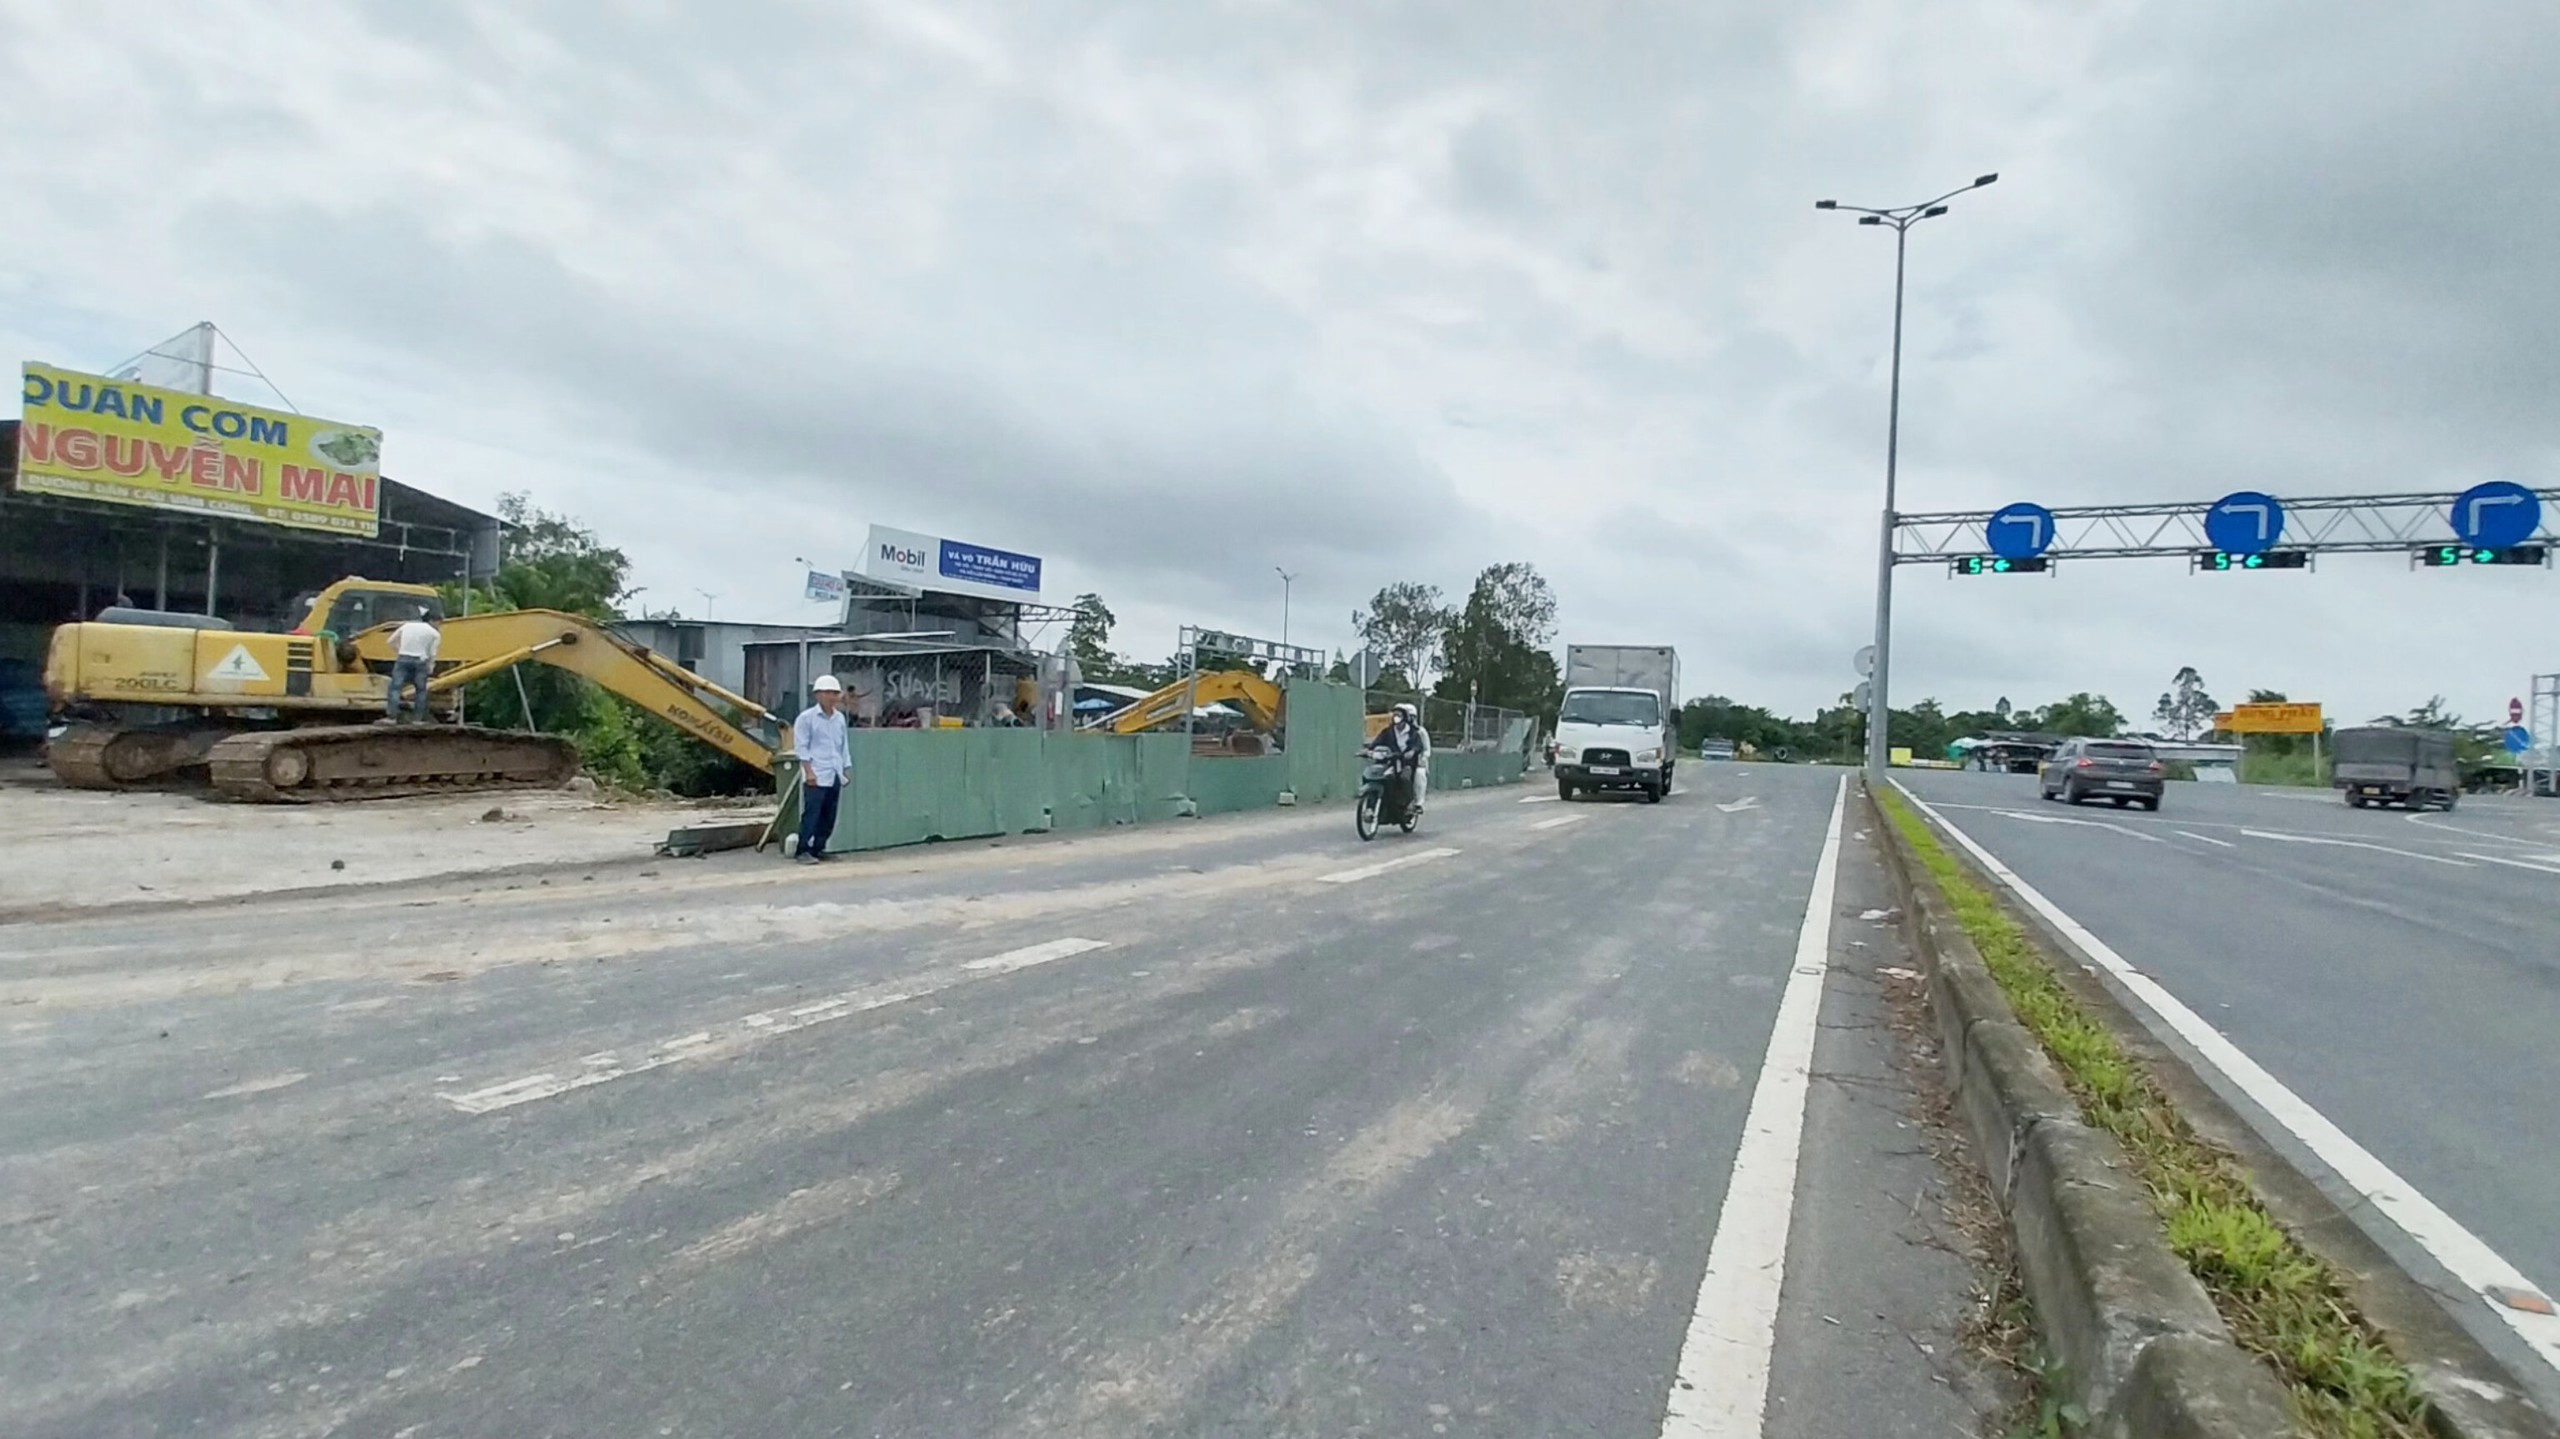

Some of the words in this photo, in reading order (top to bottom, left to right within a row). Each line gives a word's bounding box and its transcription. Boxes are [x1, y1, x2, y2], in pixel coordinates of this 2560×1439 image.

[21, 422, 262, 496] NGUYỄN
[279, 463, 377, 512] MAI
[881, 544, 926, 568] Mobil
